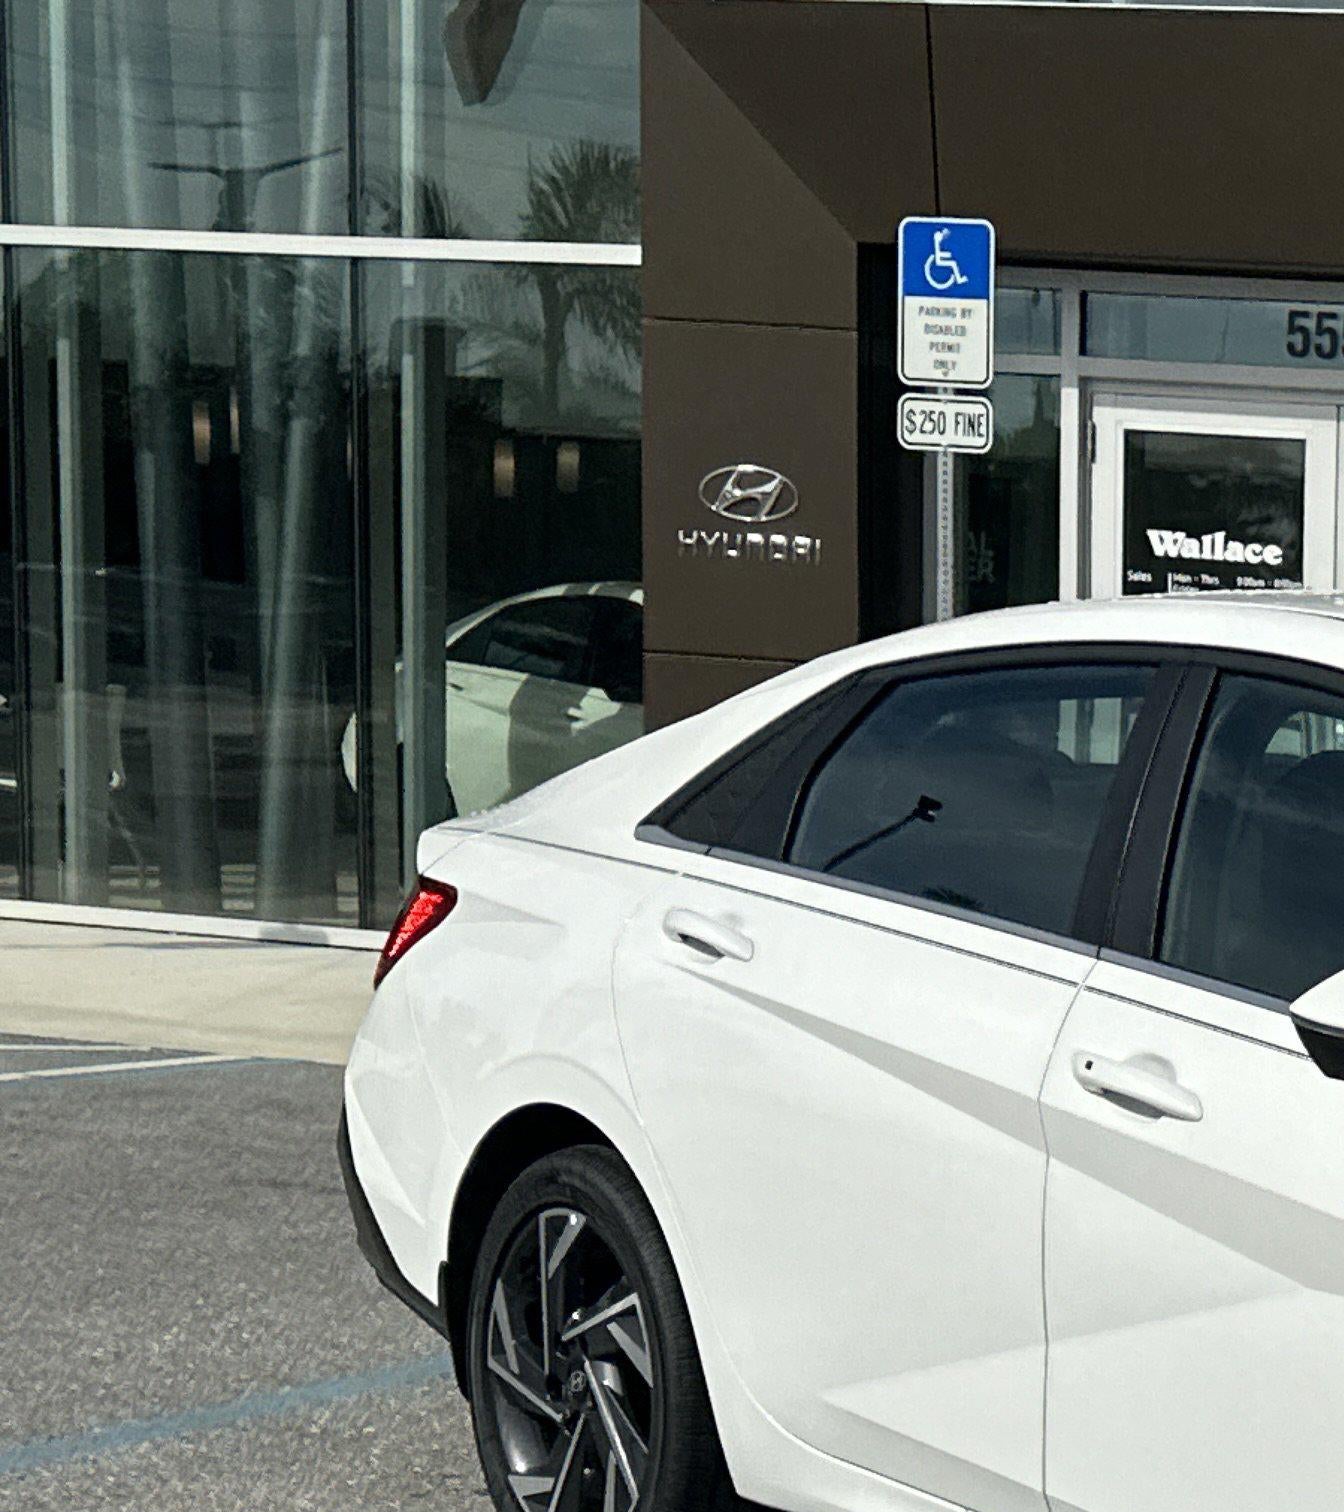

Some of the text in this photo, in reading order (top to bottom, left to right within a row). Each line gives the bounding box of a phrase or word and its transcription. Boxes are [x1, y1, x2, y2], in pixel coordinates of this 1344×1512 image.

[960, 307, 973, 320] BY
[905, 408, 985, 438] $250 FINE
[677, 529, 822, 565] HYUNDAI
[1146, 528, 1284, 566] Wallace
